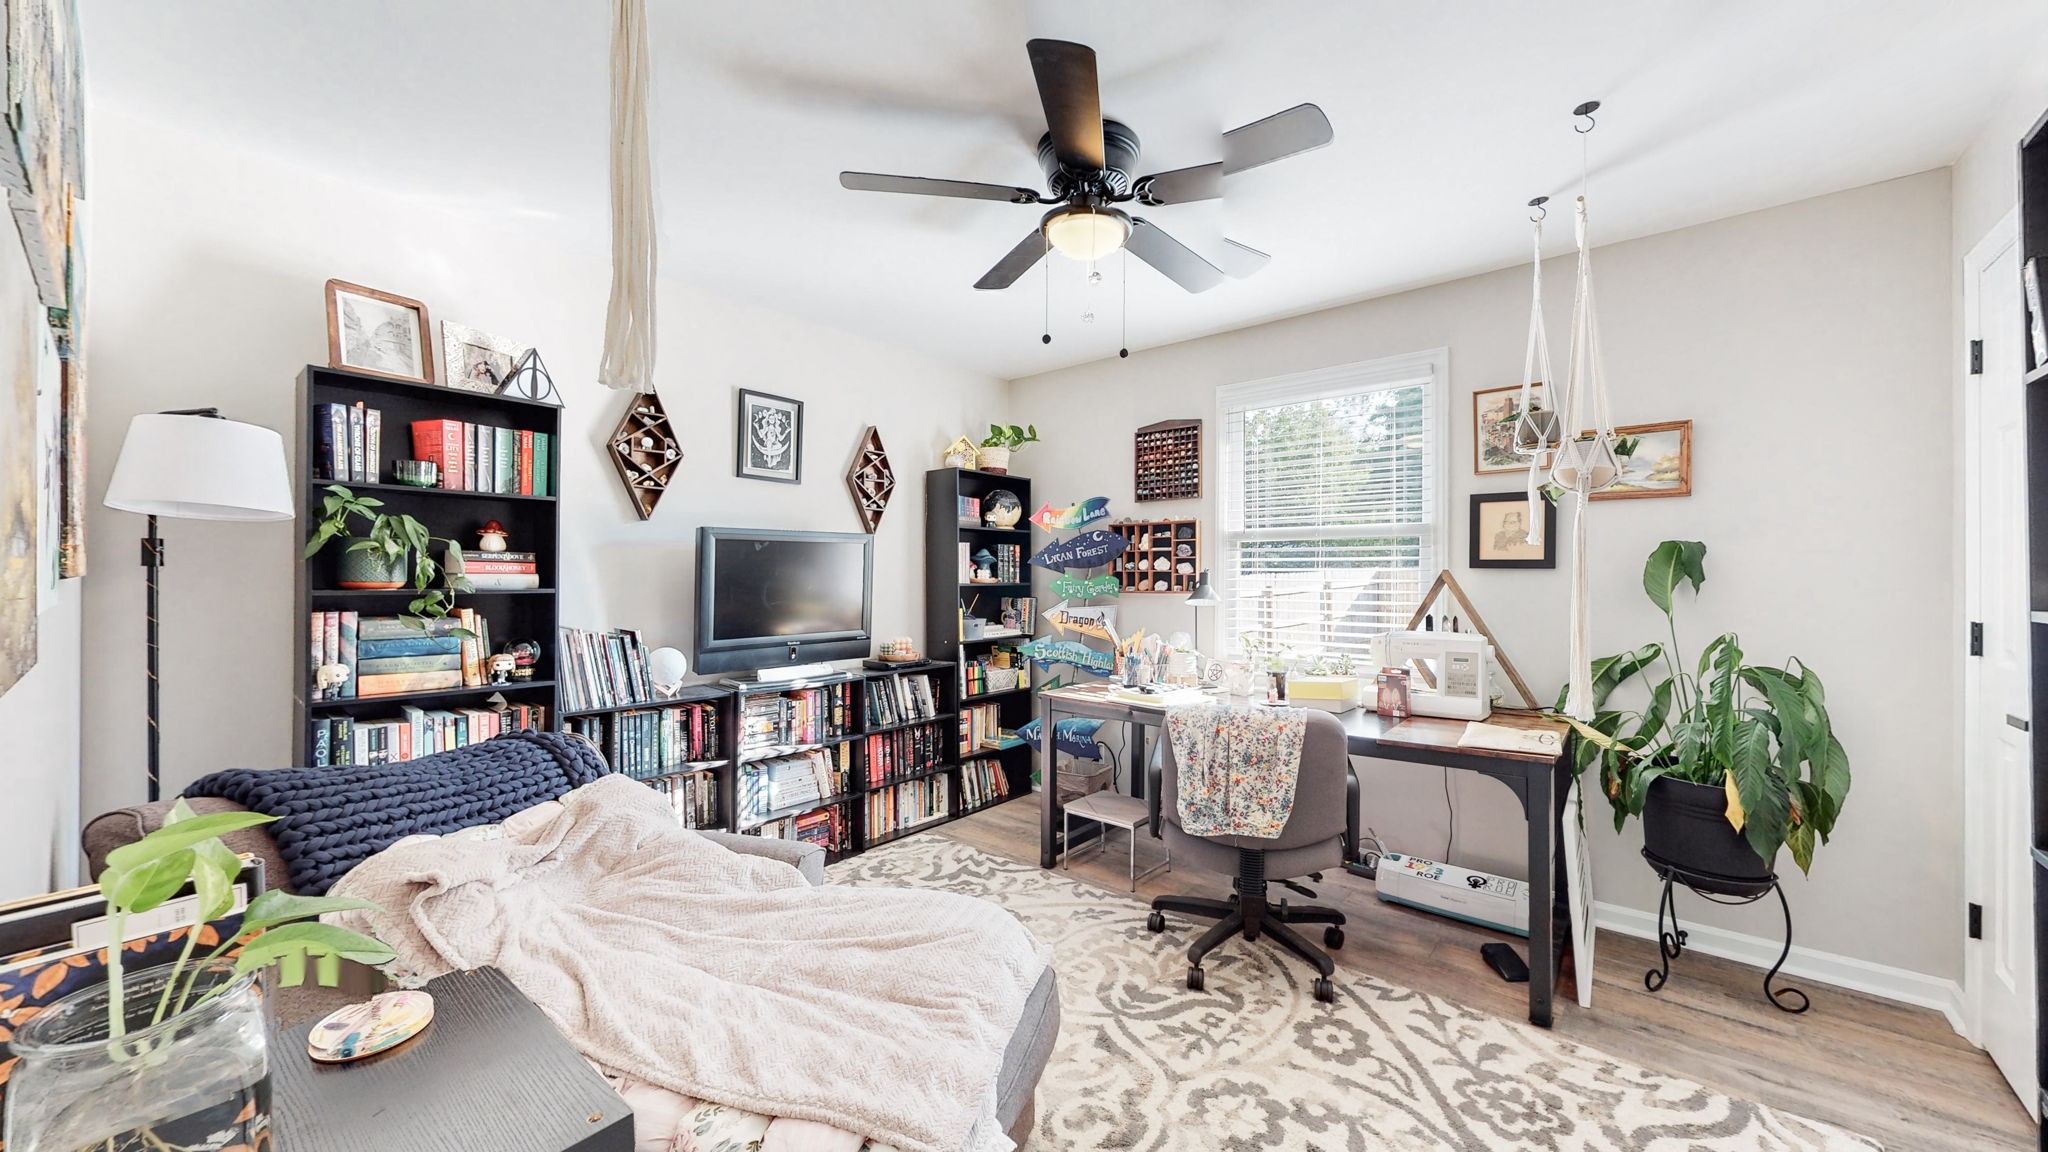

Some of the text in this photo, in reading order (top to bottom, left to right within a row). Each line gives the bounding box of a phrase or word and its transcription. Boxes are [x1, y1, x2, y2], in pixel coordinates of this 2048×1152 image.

[1043, 507, 1106, 524] Rainbow Lane
[1076, 544, 1109, 559] FOREST
[1062, 581, 1116, 597] Fairy Garden
[1059, 610, 1095, 627] Dragon
[1034, 643, 1113, 670] Scottish Highla
[1405, 861, 1444, 875] 1973
[1409, 857, 1433, 866] PRO
[1416, 871, 1440, 880] ROE
